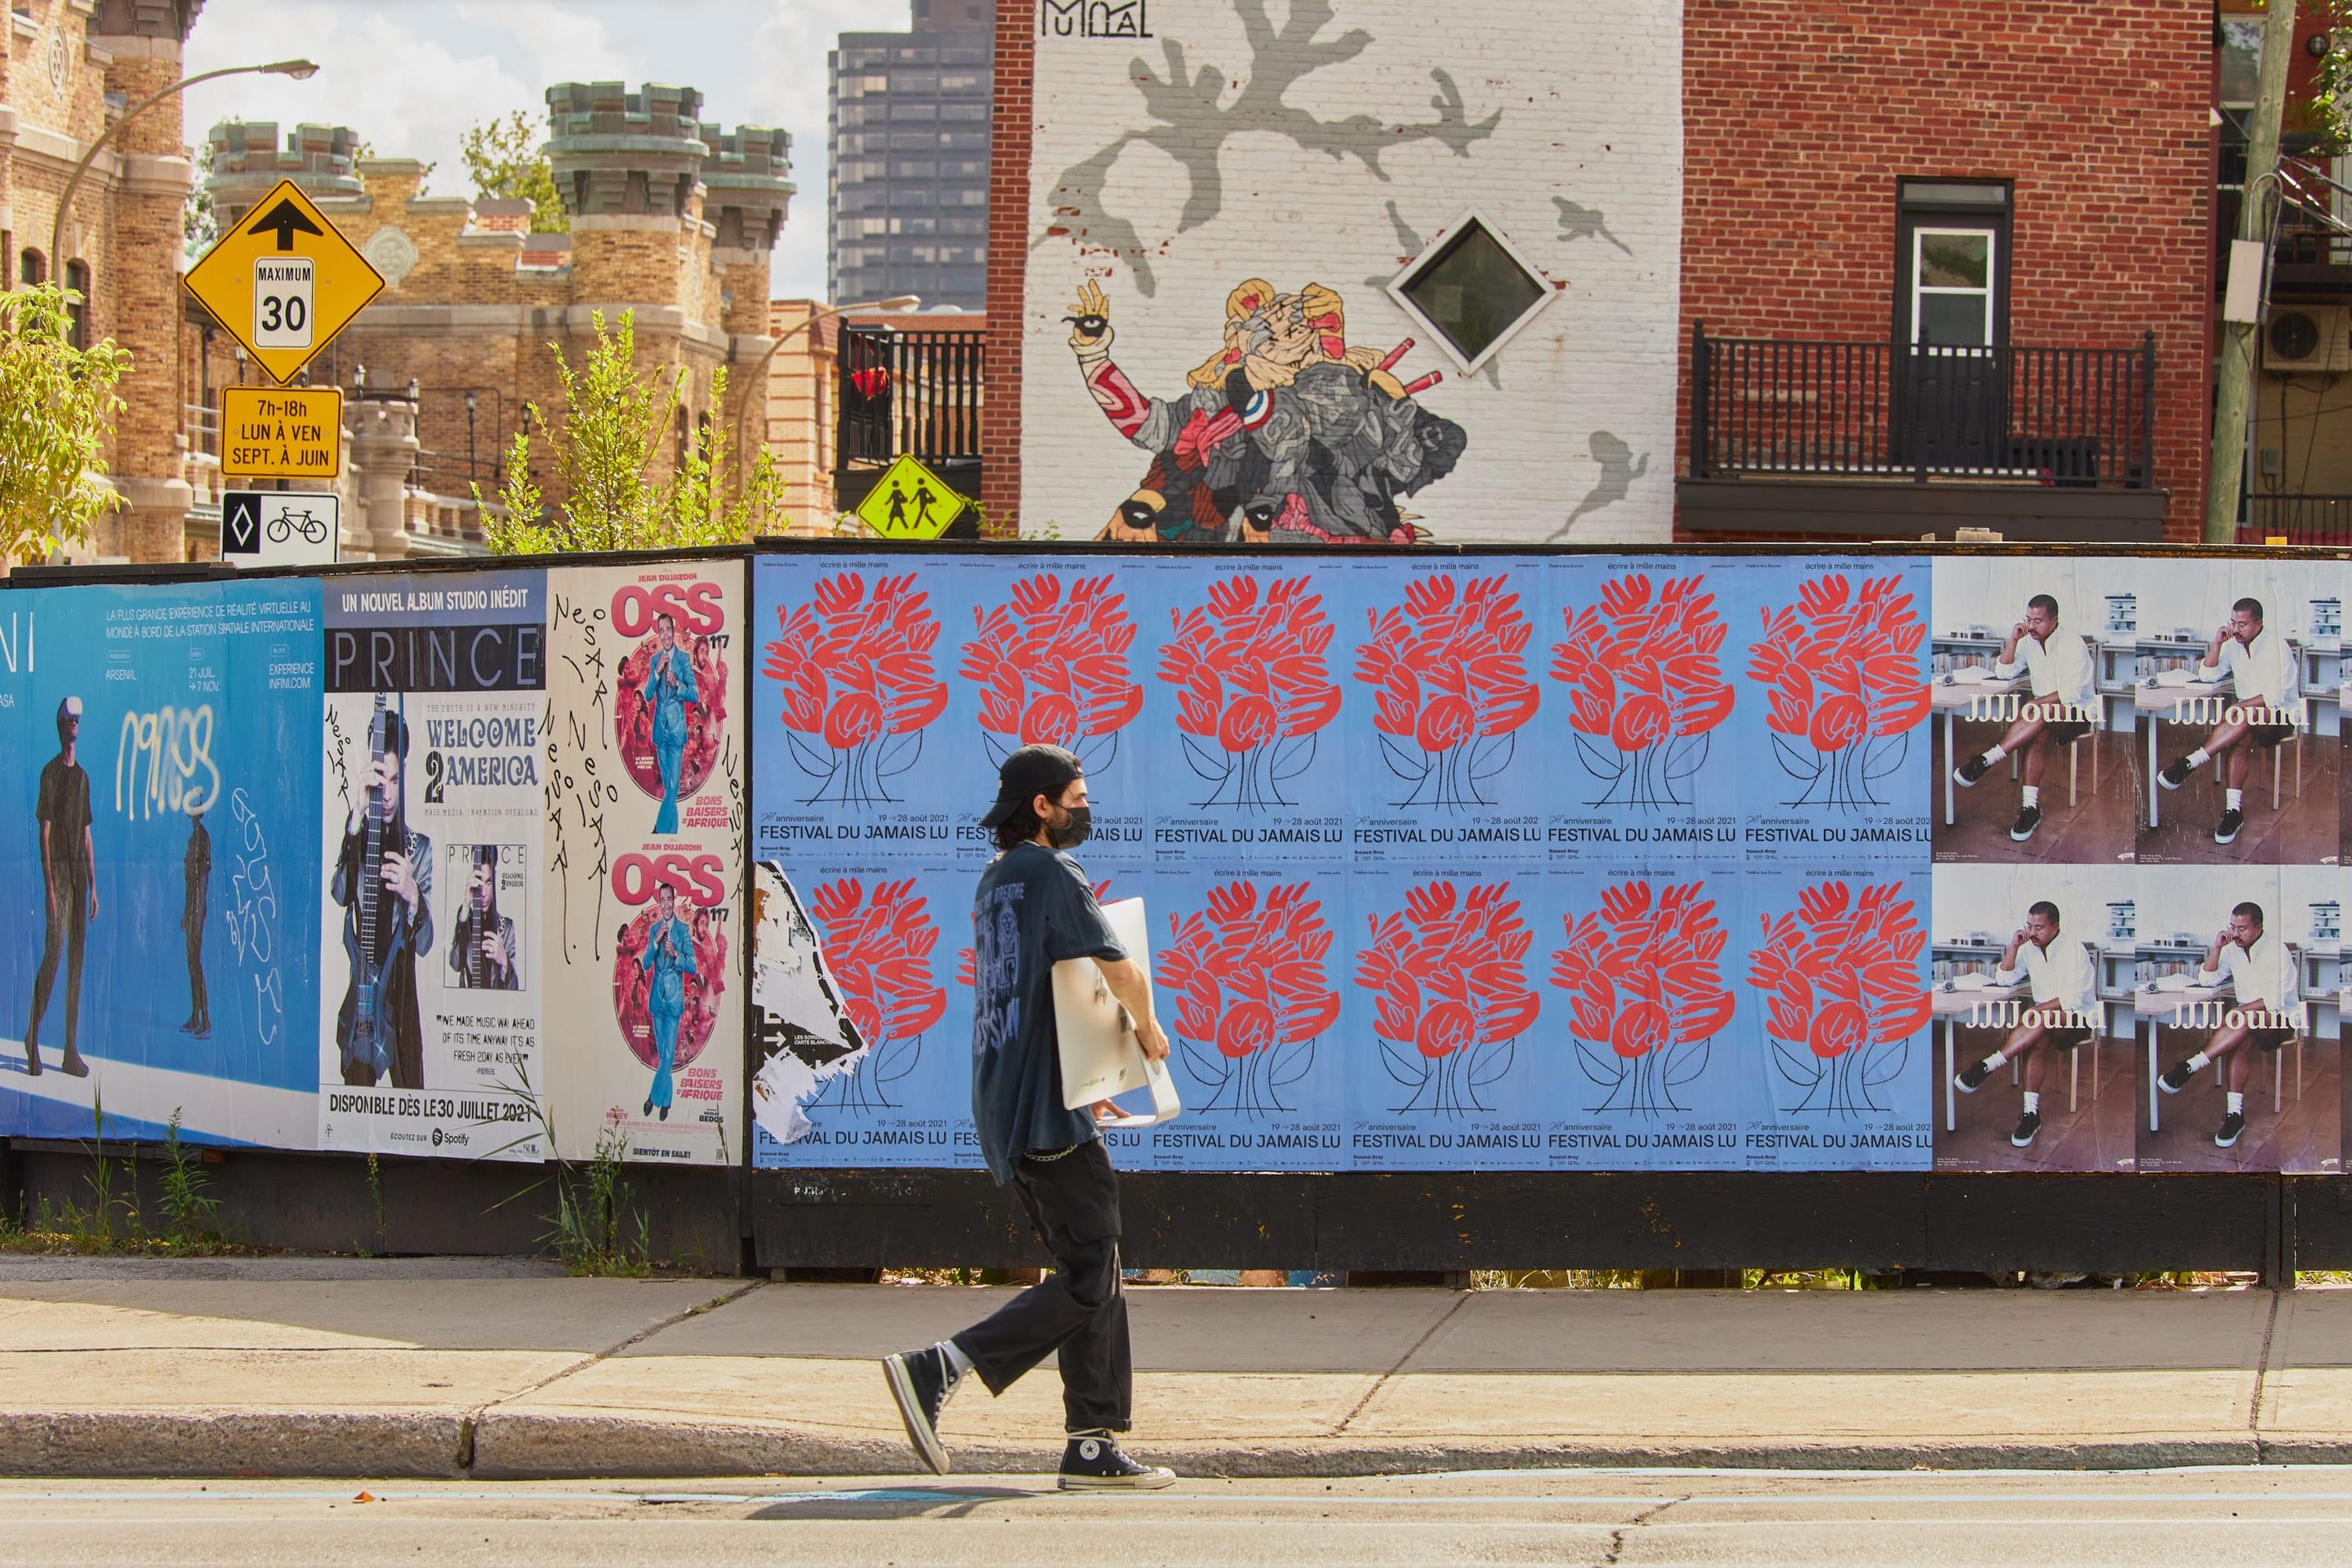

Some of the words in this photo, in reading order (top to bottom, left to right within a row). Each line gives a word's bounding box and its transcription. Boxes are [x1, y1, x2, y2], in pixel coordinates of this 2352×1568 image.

[258, 267, 310, 282] MAXIMUM
[262, 296, 305, 331] 30
[257, 400, 307, 417] 7h-18h
[241, 423, 270, 440] LUN
[275, 420, 285, 441] À
[292, 425, 320, 441] VEN
[233, 448, 274, 466] SEPT.
[280, 445, 289, 466] À
[296, 449, 328, 466] JUIN
[638, 574, 657, 582] JEAN
[659, 572, 697, 581] DUJARDIN
[342, 594, 357, 612] UN
[362, 592, 404, 612] NOUVEL
[408, 591, 443, 611] ALBUM
[448, 590, 487, 609] STUDIO
[491, 585, 528, 608] INÉDIT
[107, 610, 115, 621] LA
[118, 609, 134, 621] PLUS
[136, 608, 167, 620] GRANDE
[216, 605, 225, 617] DE
[259, 602, 298, 614] VIRTUELLE
[301, 601, 310, 613] AU
[611, 582, 724, 638] OSS
[141, 626, 162, 638] BORD
[164, 626, 173, 637] DE
[176, 626, 185, 636] LA
[187, 624, 216, 635] STATION
[218, 622, 249, 634] SPATIALE
[252, 619, 314, 632] INTERNATIONALE
[710, 635, 729, 649] 117
[335, 627, 537, 688] PRINCE
[105, 669, 136, 680] ARSENAL
[189, 668, 196, 679] 21
[269, 662, 314, 675] EXPERIENCE
[197, 681, 201, 692] 7
[203, 681, 220, 692] NOV.
[269, 677, 310, 689] INFINI.COM
[441, 704, 463, 712] TRUTH
[466, 704, 474, 712] IS
[477, 704, 480, 712] A
[484, 704, 498, 712] NEW
[502, 703, 536, 711] MINORITY
[426, 717, 536, 748] WELCOME
[425, 751, 443, 804] 2
[446, 755, 538, 786] AMERICA
[696, 796, 722, 806] BONS
[686, 807, 728, 817] BAISERS
[929, 814, 949, 822] 2021
[682, 817, 728, 828] D'AFRIQUE
[760, 826, 833, 839] FESTIVAL
[838, 826, 860, 839] DU
[865, 826, 926, 839] JAMAIS
[930, 826, 948, 839] LU
[1155, 830, 1227, 842] FESTIVAL
[1232, 830, 1254, 842] DU
[1258, 829, 1320, 842] JAMAIS
[1325, 830, 1343, 842] LU
[1746, 829, 1819, 842] FESTIVAL
[1824, 829, 1846, 842] DU
[1851, 828, 1912, 842] JAMAIS
[1917, 829, 1931, 842] LU
[663, 843, 702, 851] DUJARDIN
[612, 853, 724, 907] OSS
[710, 908, 728, 922] 117
[457, 1016, 474, 1027] MADE
[476, 1017, 496, 1027] MUSIC
[512, 1018, 534, 1029] AHEAD
[443, 1033, 451, 1043] OF
[454, 1033, 464, 1044] ITS
[466, 1033, 481, 1045] TIME
[483, 1034, 507, 1045] ANYWAY
[526, 1036, 534, 1047] AS
[454, 1050, 474, 1062] FRESH
[478, 1052, 493, 1062] 2DAY
[496, 1053, 503, 1063] AS
[688, 1068, 717, 1078] BONS
[680, 1079, 723, 1089] BAISERS
[676, 1089, 723, 1101] D'AFRIQUE
[330, 1094, 394, 1116] DISPONIBLE
[399, 1094, 420, 1116] DÈS
[424, 1101, 436, 1117] LE
[438, 1099, 454, 1118] 30
[457, 1102, 499, 1120] JUILLET
[503, 1103, 532, 1122] 2021
[391, 1132, 415, 1141] ÉCOUTEZ
[444, 1133, 470, 1146] Spotify
[760, 1132, 831, 1144] FEIVAL
[836, 1132, 858, 1144] DU
[863, 1131, 924, 1144] JAMAIS
[929, 1132, 946, 1144] LU
[1154, 1134, 1226, 1147] FESTIVAL
[1231, 1134, 1252, 1147] DU
[1257, 1134, 1318, 1147] JAMAIS
[1322, 1134, 1340, 1147] LU
[1549, 1135, 1621, 1147] FESTIVAL
[1626, 1135, 1647, 1147] DU
[1652, 1134, 1714, 1147] JAMAIS
[1718, 1135, 1736, 1147] LU
[633, 1147, 659, 1156] BIENTÔT
